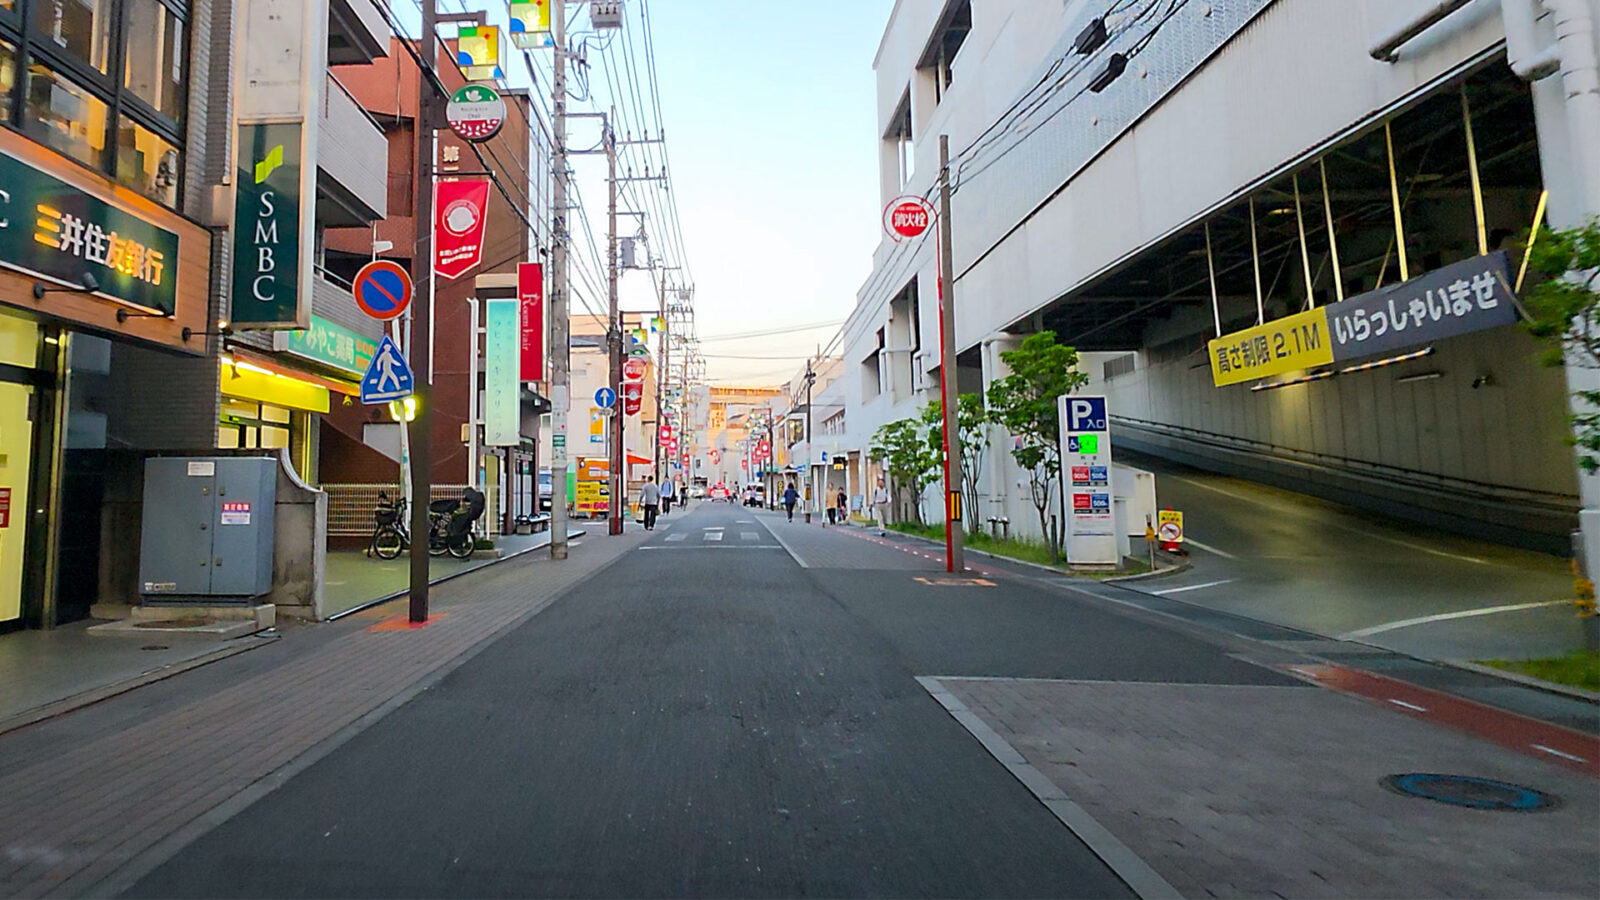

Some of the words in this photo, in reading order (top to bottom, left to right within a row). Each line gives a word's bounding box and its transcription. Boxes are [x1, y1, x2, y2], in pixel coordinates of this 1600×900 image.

[34, 204, 164, 286] 三井住友銀行
[253, 191, 279, 301] SMBC
[894, 212, 926, 228] 消火栓
[1335, 270, 1498, 345] いらっしゃいませ
[1216, 335, 1271, 374] 高さ制限
[1273, 322, 1321, 359] 2.1M
[1071, 400, 1092, 429] P
[1086, 418, 1105, 429] 入口
